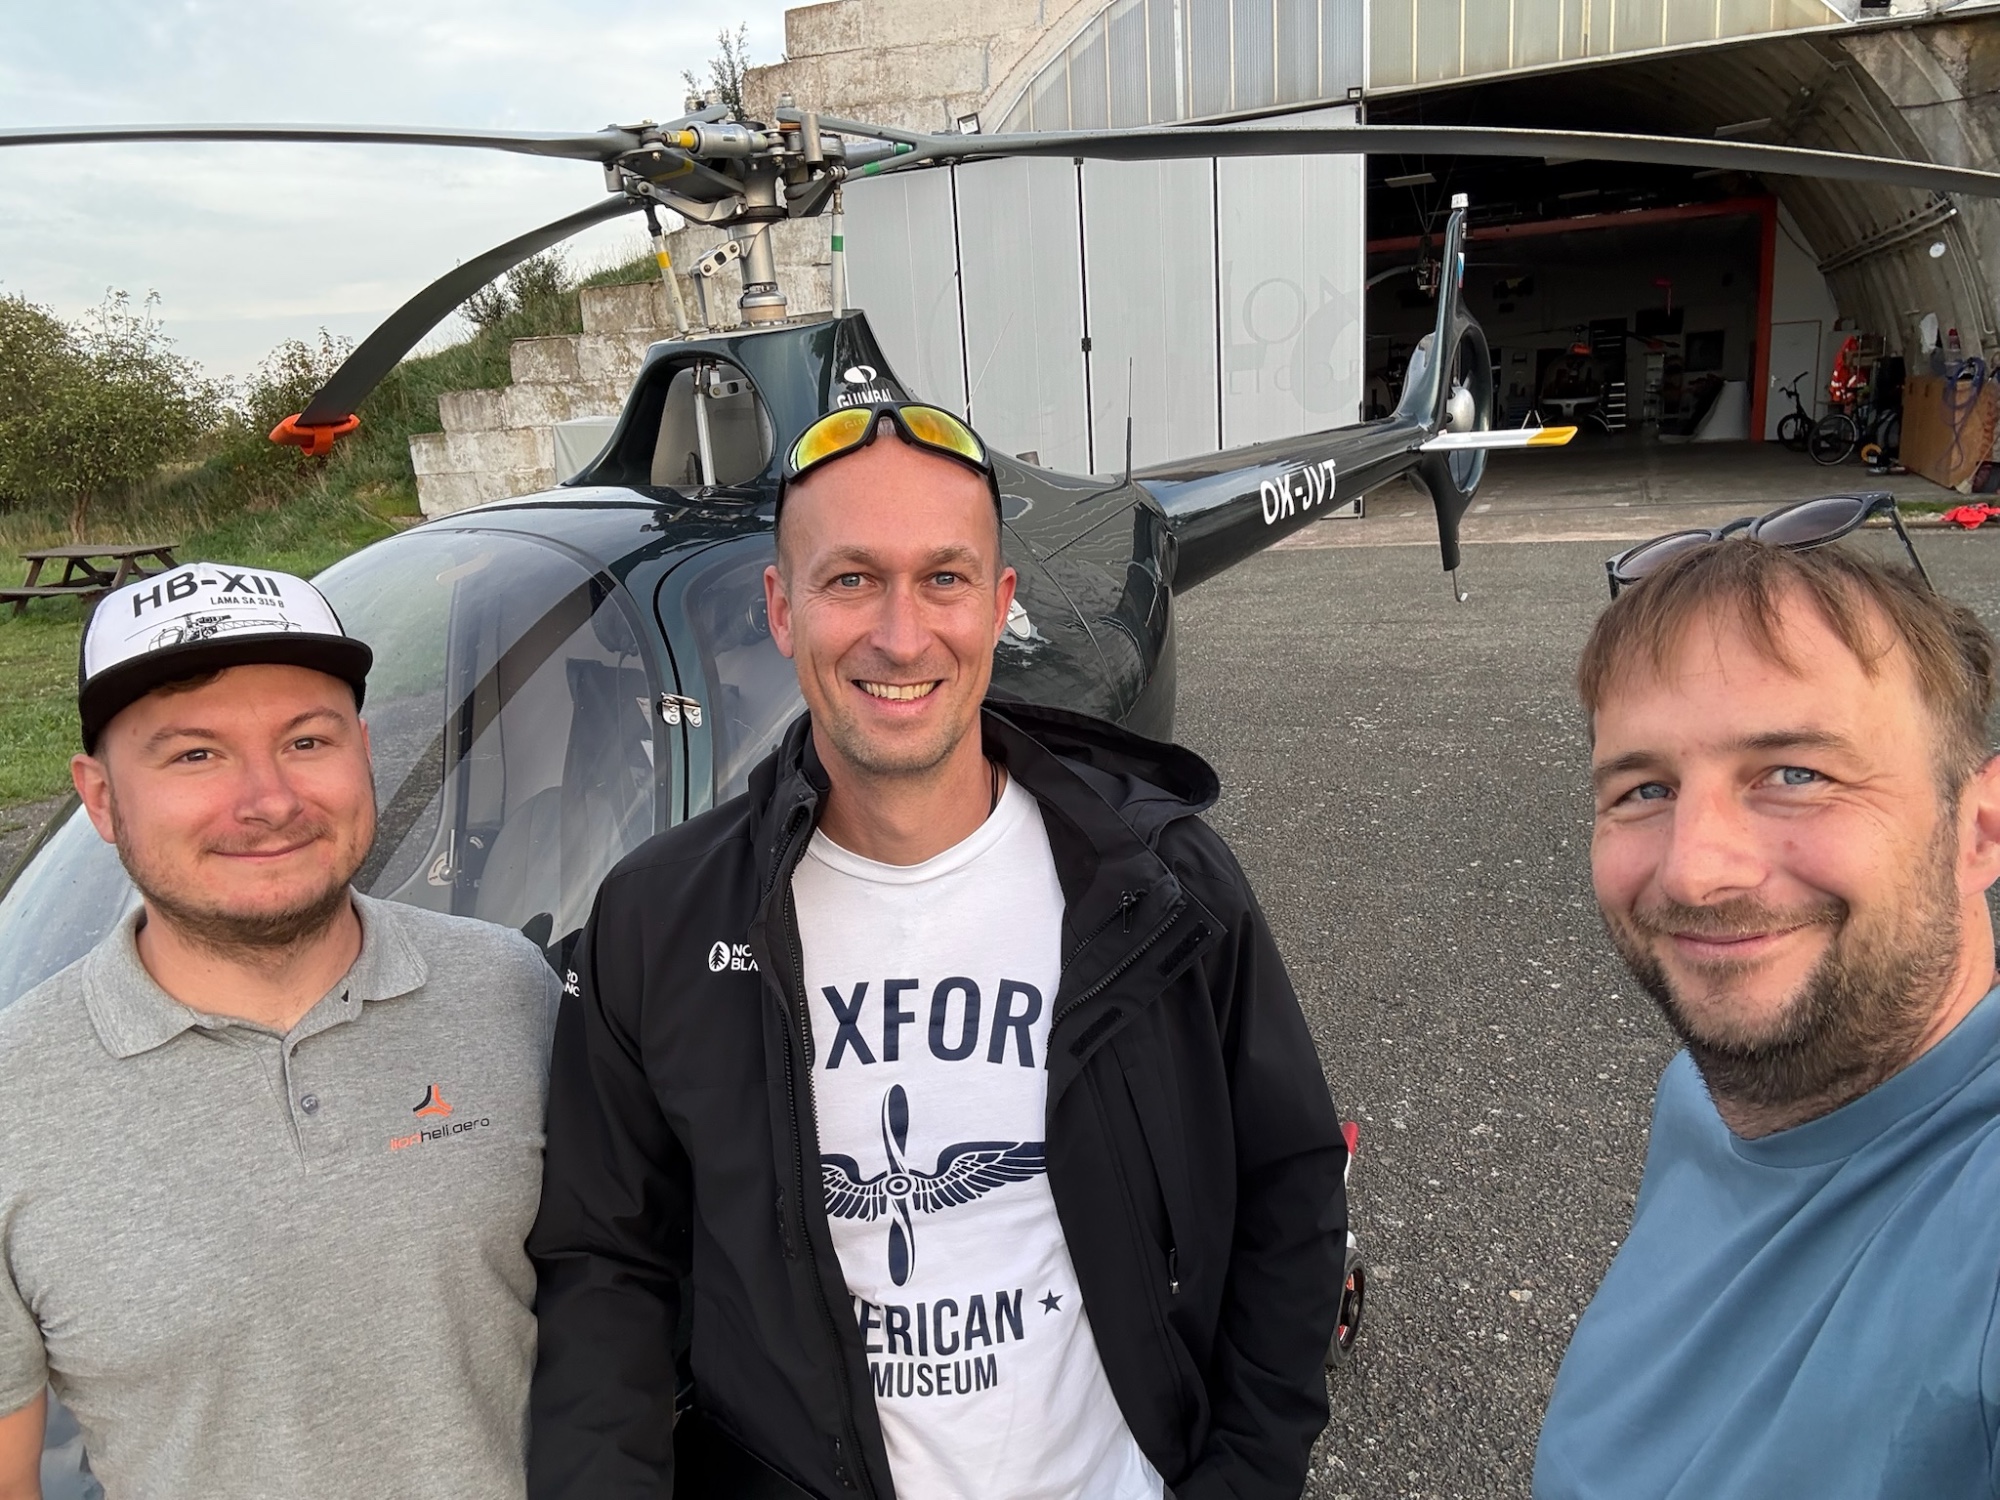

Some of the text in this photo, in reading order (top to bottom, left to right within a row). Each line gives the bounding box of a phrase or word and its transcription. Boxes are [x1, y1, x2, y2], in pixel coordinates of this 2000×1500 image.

[1260, 459, 1336, 525] OK-JVT
[133, 570, 281, 618] HB-XII
[210, 596, 240, 605] LAMA
[242, 596, 256, 605] SA
[257, 597, 276, 607] 315
[731, 957, 761, 972] BLA
[564, 981, 580, 998] NC
[812, 976, 1048, 1070] XFOR
[851, 1288, 1024, 1357] ERICAN
[870, 1353, 998, 1398] MUSEUM
